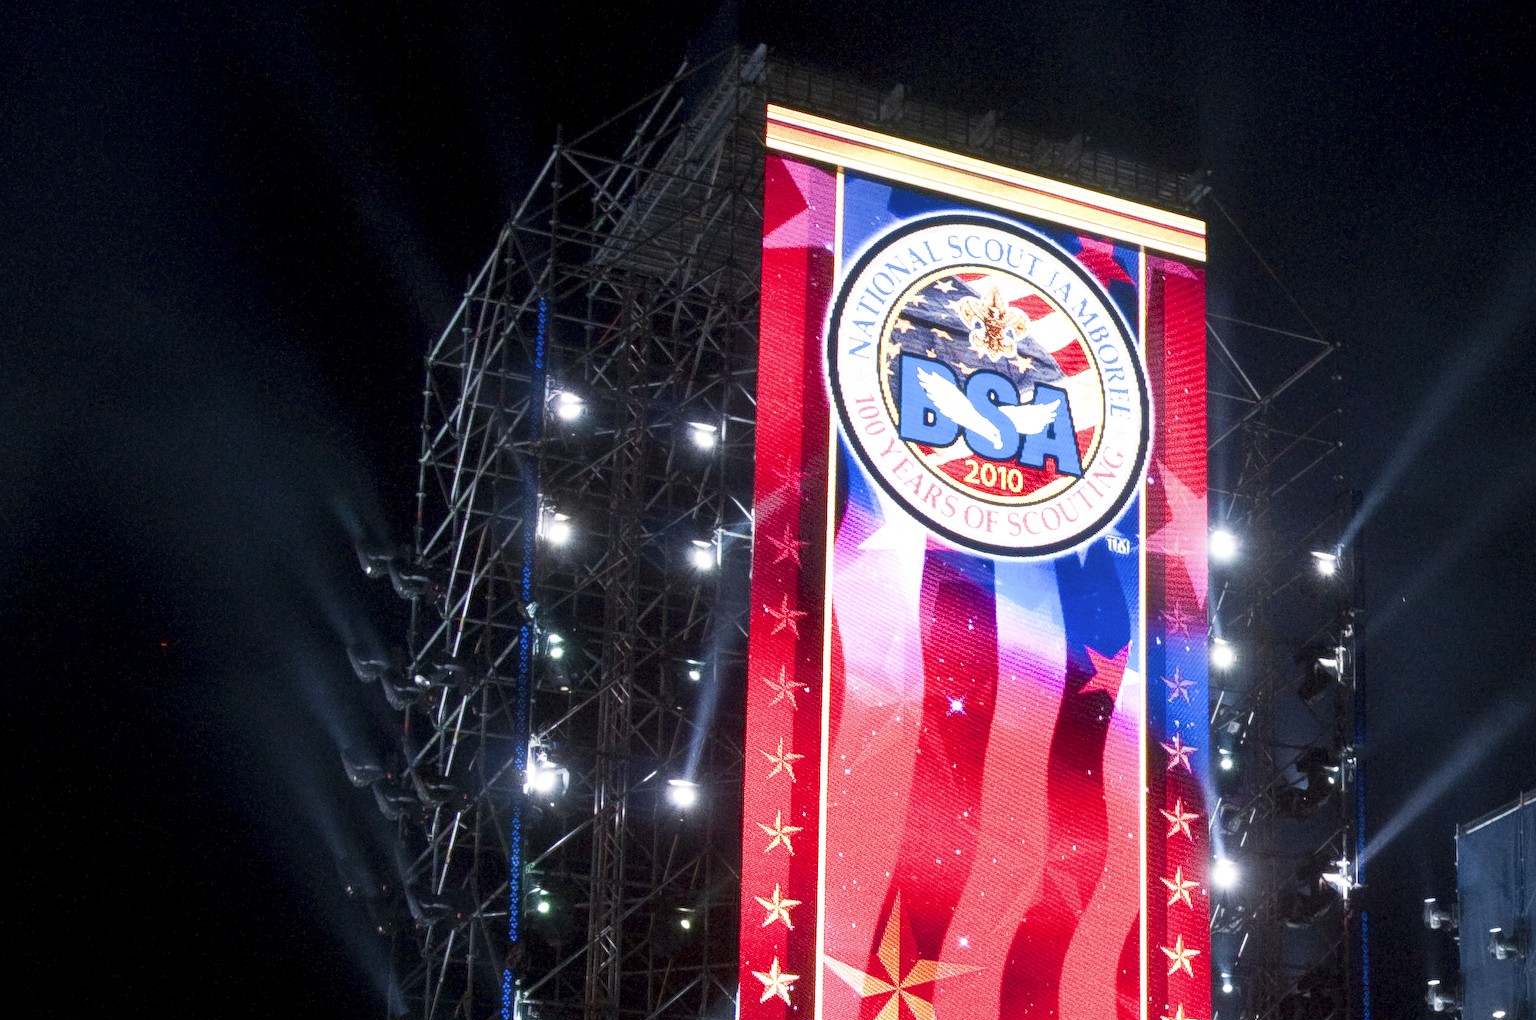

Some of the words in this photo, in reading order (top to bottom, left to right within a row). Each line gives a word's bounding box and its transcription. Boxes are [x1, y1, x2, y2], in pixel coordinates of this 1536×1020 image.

[849, 240, 943, 359] NATIONAL
[947, 235, 1044, 276] SCOUT
[1043, 266, 1131, 420] JAMBOREE
[855, 396, 886, 436] 100
[880, 438, 956, 518] YEARS
[963, 504, 999, 533] OF
[1007, 446, 1125, 537] SCOUTING
[899, 351, 1084, 478] BSA
[962, 458, 1025, 494] 2010
